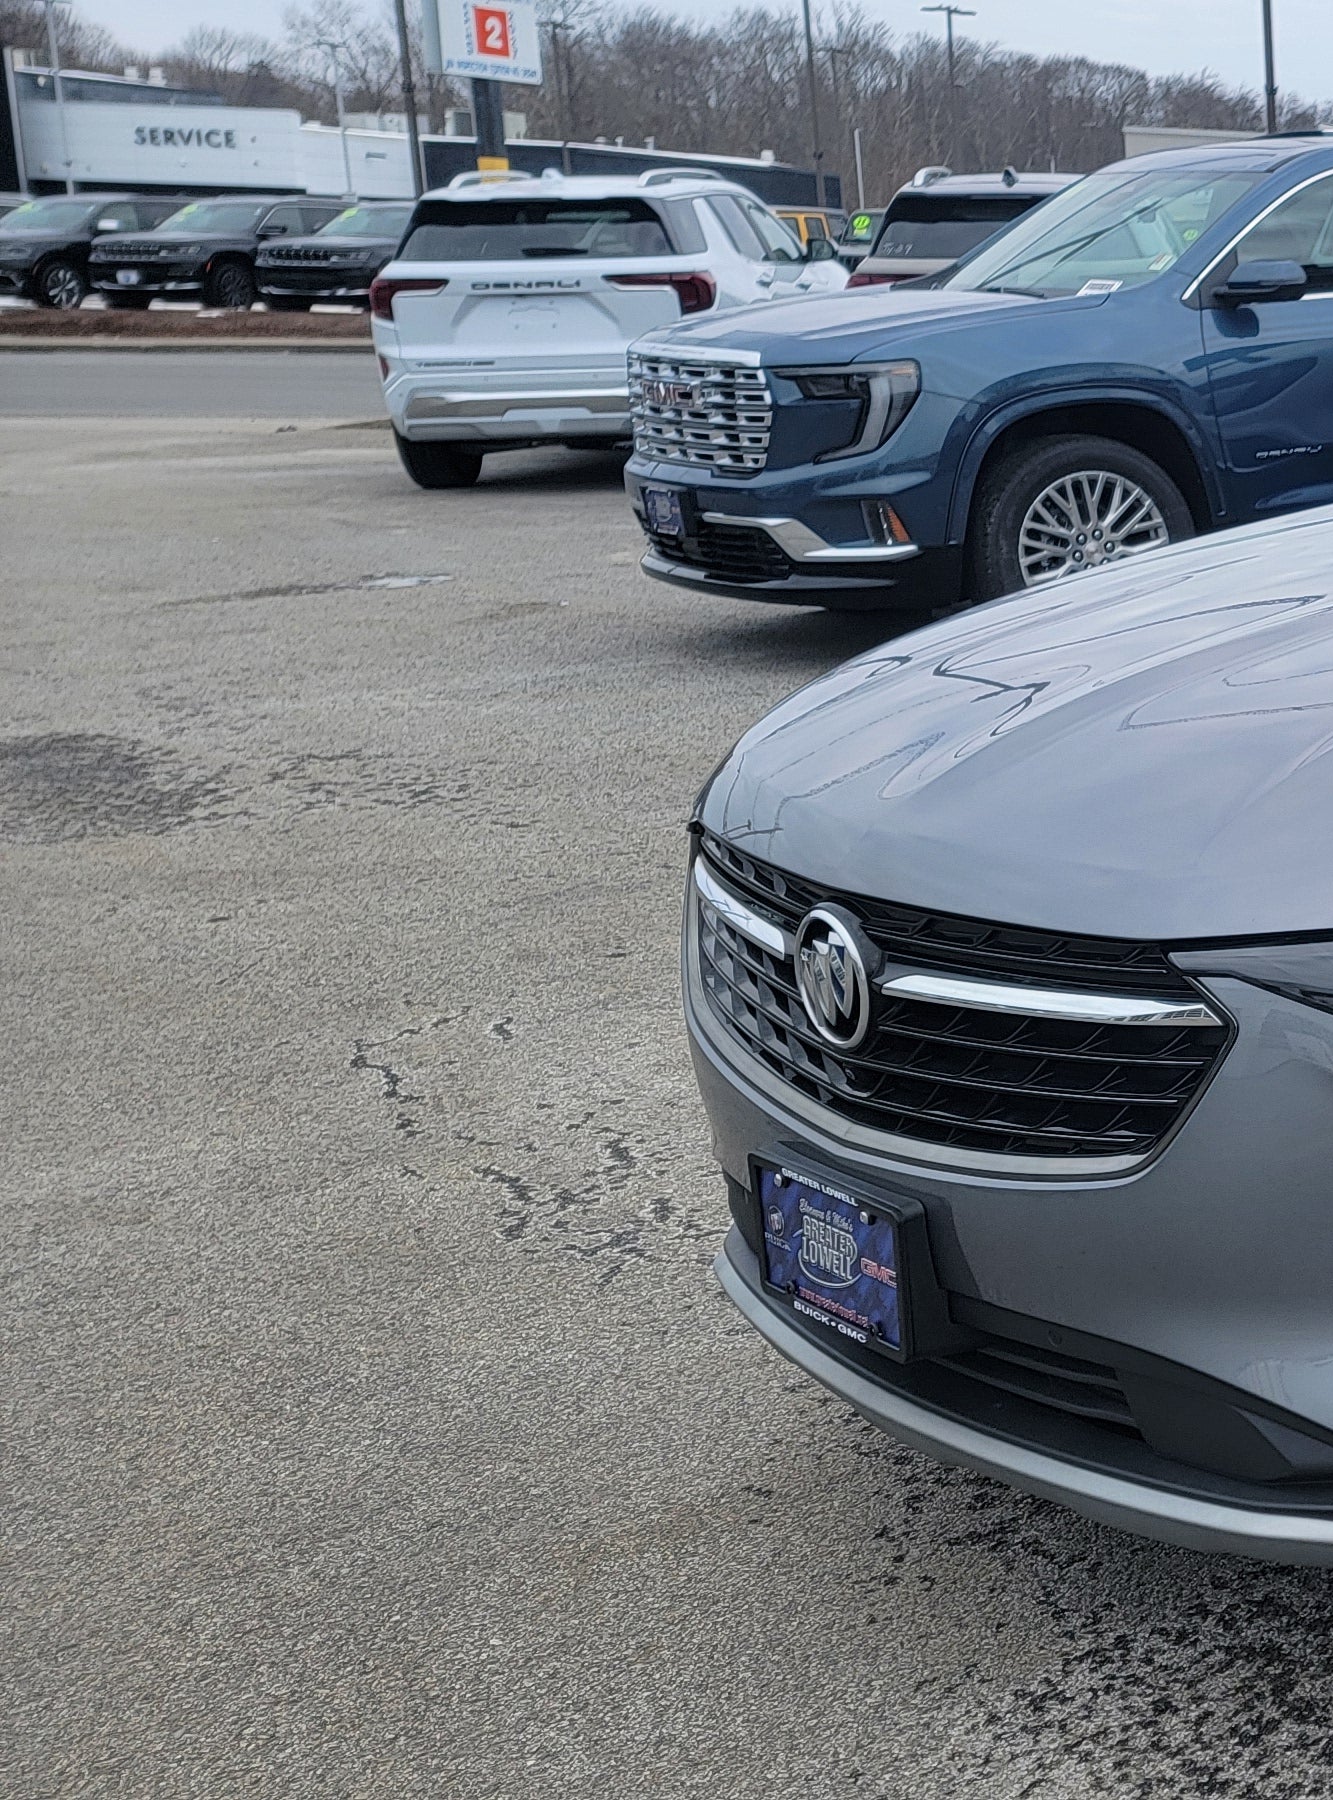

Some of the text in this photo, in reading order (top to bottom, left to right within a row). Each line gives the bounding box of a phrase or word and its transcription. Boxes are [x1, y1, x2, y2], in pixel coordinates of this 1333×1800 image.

[485, 15, 503, 49] 2
[134, 126, 236, 148] SERVICE
[471, 280, 581, 290] DENALI
[642, 380, 695, 408] GMC
[781, 1167, 859, 1207] GREATER LOWELL
[802, 1214, 855, 1259] GREATER
[801, 1236, 854, 1281] LOWELL
[861, 1257, 897, 1288] GMC
[794, 1300, 867, 1344] BUICK GMC
